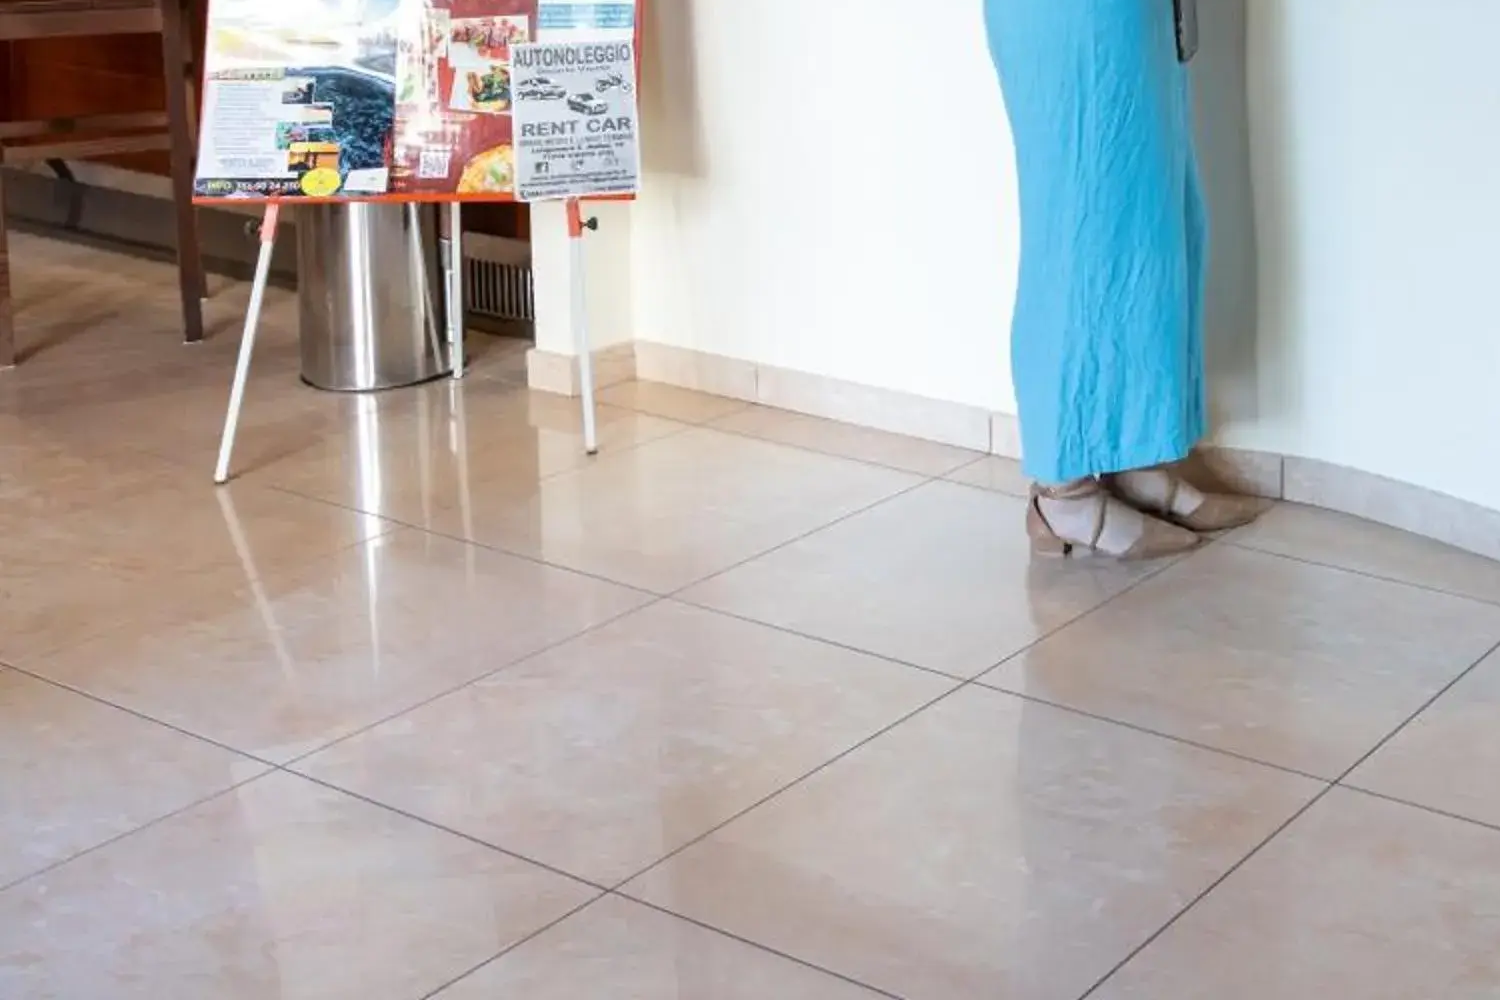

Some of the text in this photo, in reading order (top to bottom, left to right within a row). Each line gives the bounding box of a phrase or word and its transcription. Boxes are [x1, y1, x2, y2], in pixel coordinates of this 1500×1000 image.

[513, 43, 630, 67] AUTONOLEGGIO
[521, 117, 631, 136] RENT CAR
